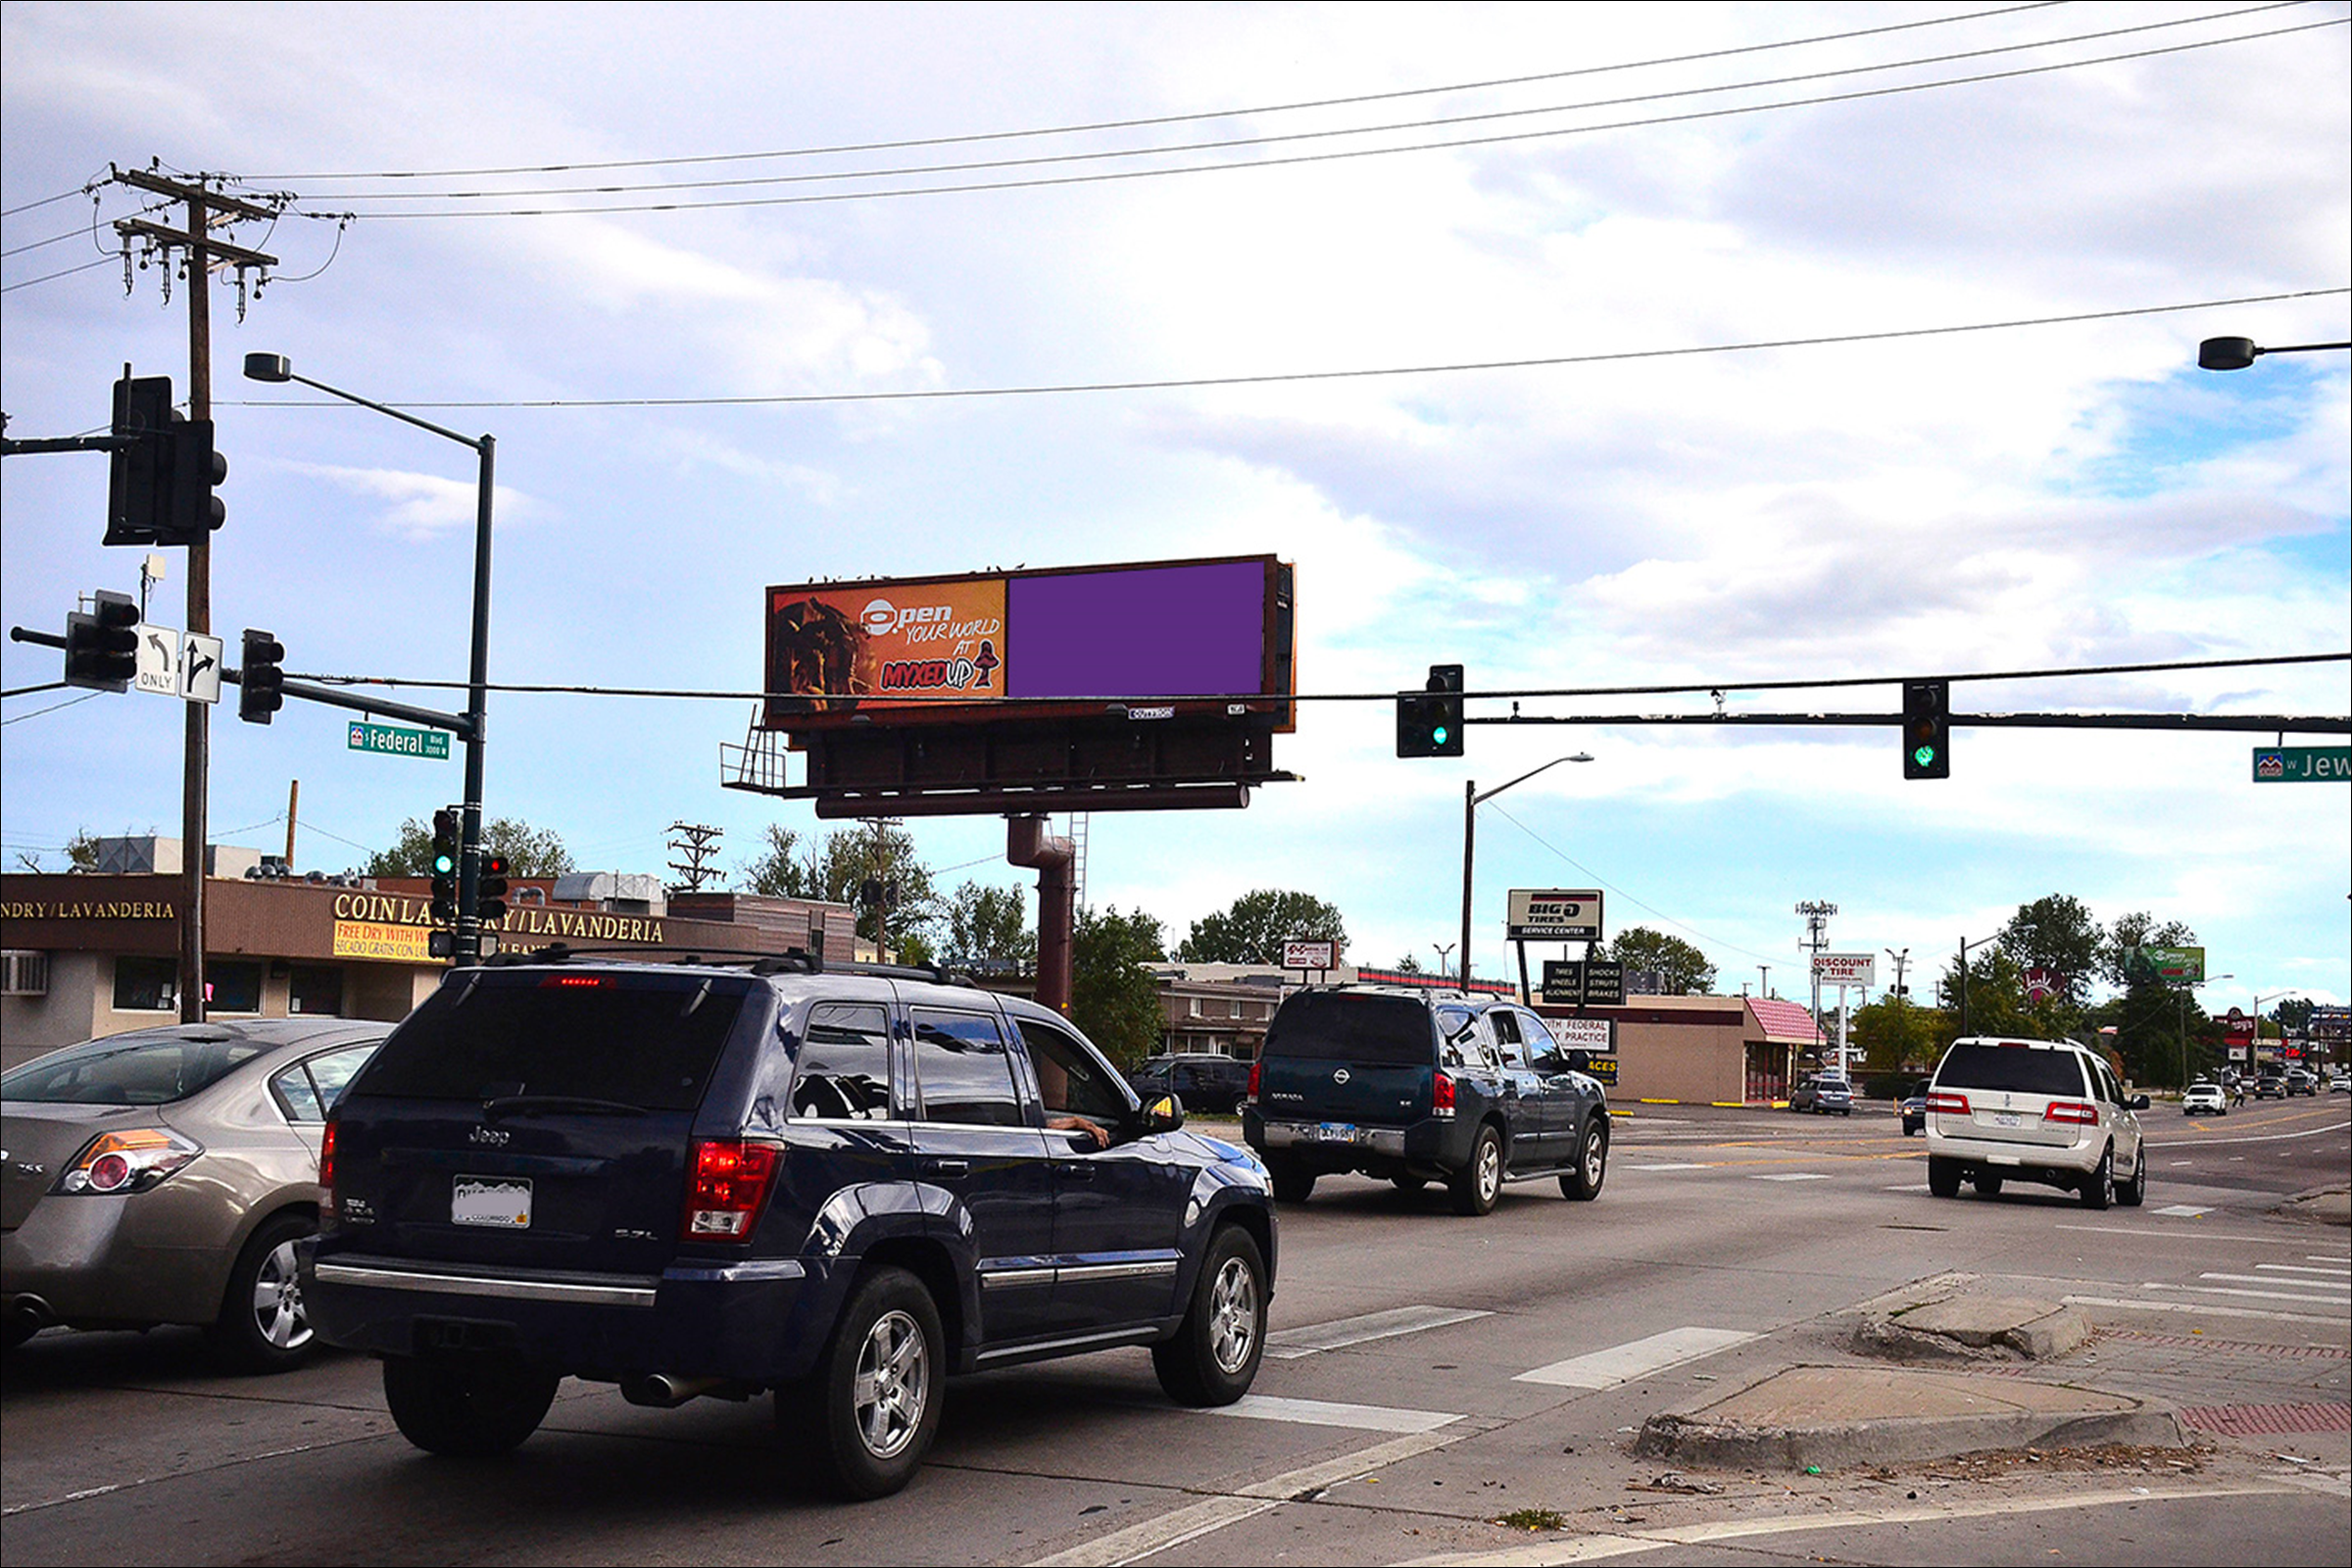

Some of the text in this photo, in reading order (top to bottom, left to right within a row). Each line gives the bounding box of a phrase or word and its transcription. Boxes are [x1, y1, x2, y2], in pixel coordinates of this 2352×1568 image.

[906, 617, 1001, 645] YOUR WORLD
[952, 640, 974, 657] AT
[141, 671, 172, 688] ONLY
[370, 728, 423, 754] Federal
[2301, 754, 2352, 777] Jew
[334, 893, 396, 921] COIN
[1528, 904, 1562, 914] BIG
[337, 923, 361, 939] FREE
[1814, 957, 1872, 967] DISCOUNT
[1588, 967, 1621, 977] SHOCKS
[1830, 967, 1855, 976] TIRE
[1588, 990, 1620, 999] BRAKES
[1566, 1020, 1607, 1031] FEDERAL
[1565, 1031, 1607, 1043] PRACTICE
[468, 1125, 511, 1147] Jeep
